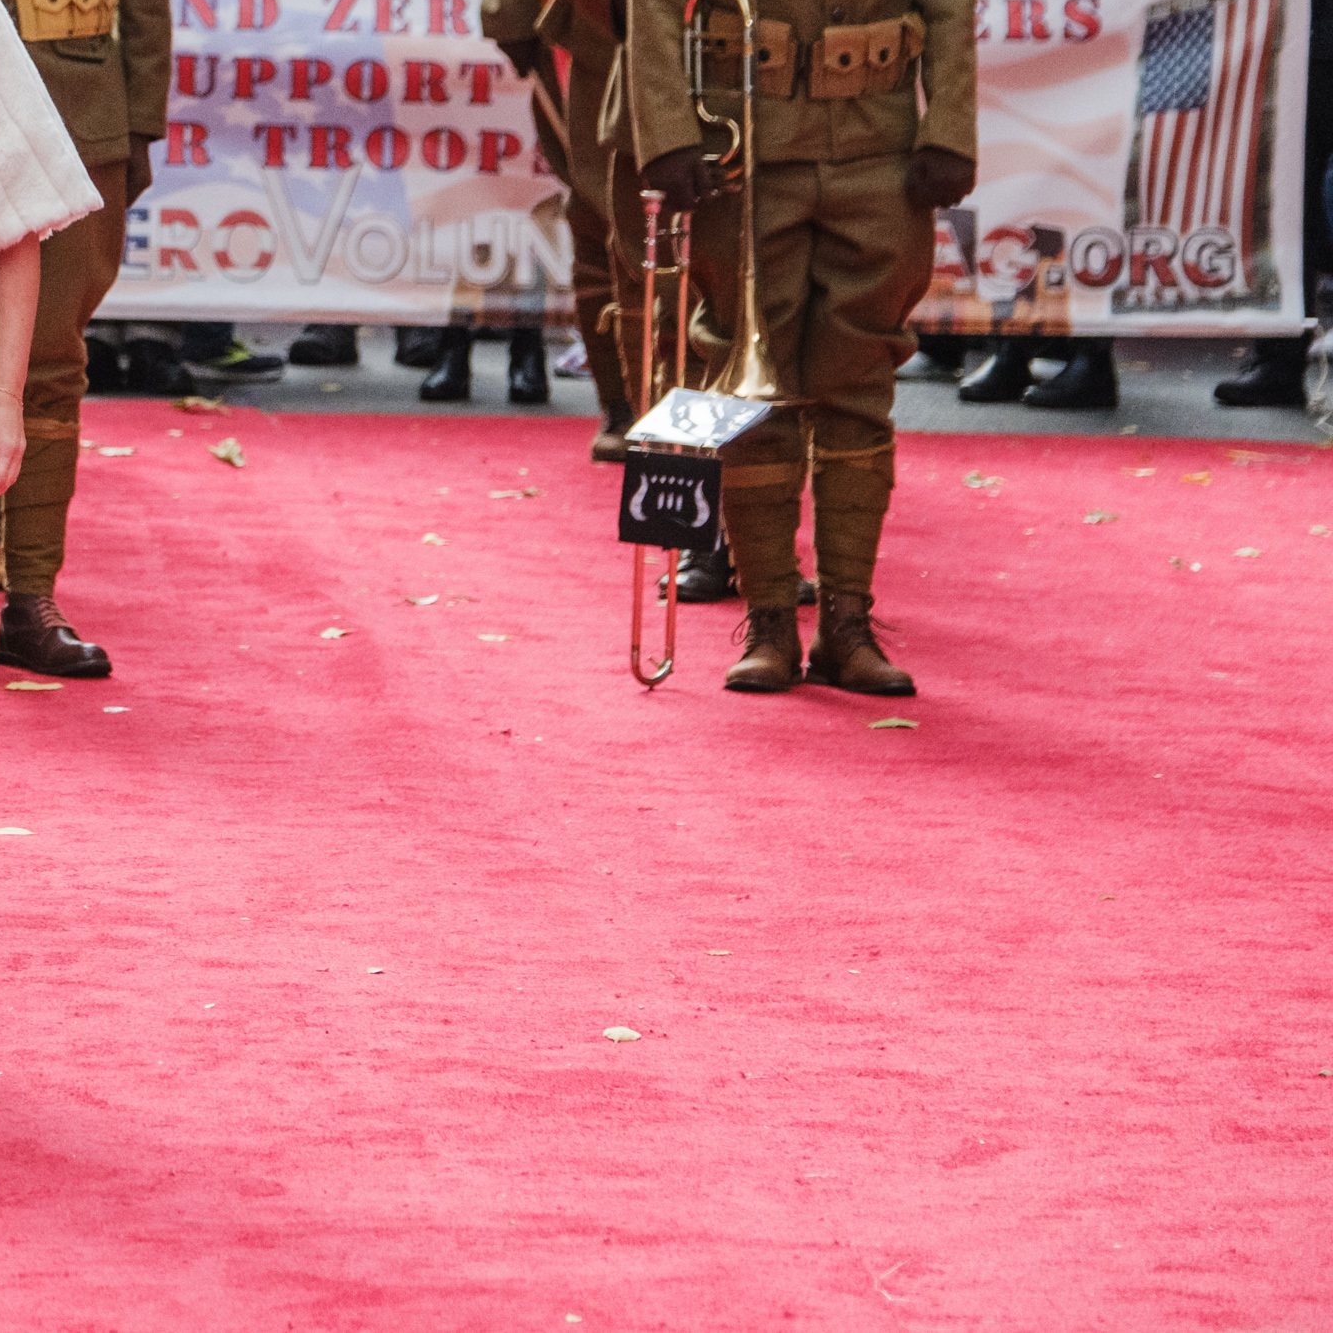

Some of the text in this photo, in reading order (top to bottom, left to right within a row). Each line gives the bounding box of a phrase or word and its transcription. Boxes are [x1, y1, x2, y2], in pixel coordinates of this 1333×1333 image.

[177, 54, 503, 104] UPPORT
[167, 122, 549, 174] R TROOP
[935, 220, 1236, 300] AG.ORG
